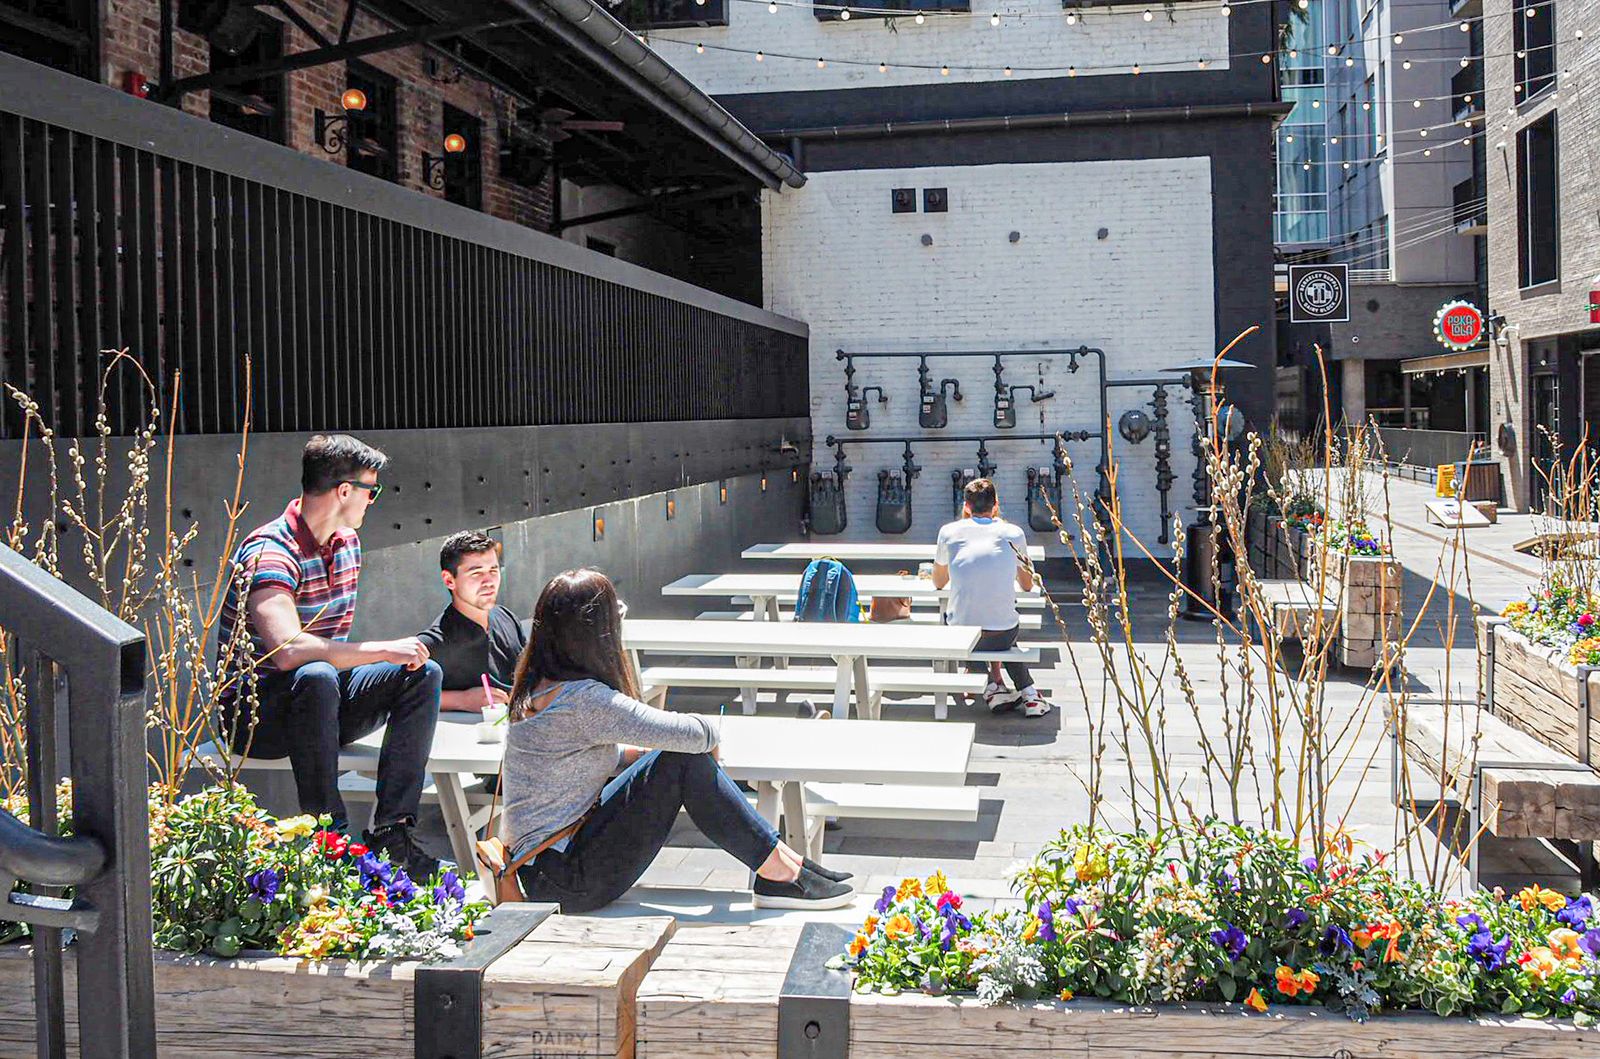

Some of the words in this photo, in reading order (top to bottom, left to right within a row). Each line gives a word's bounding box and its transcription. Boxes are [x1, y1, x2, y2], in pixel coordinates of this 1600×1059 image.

[1300, 273, 1323, 292] BERKELEY
[1323, 274, 1339, 290] SUPPLY
[1303, 302, 1319, 313] DAIRY
[1320, 301, 1336, 313] BLOCK
[1452, 324, 1473, 336] LOLA
[532, 1031, 588, 1045] DAIRY
